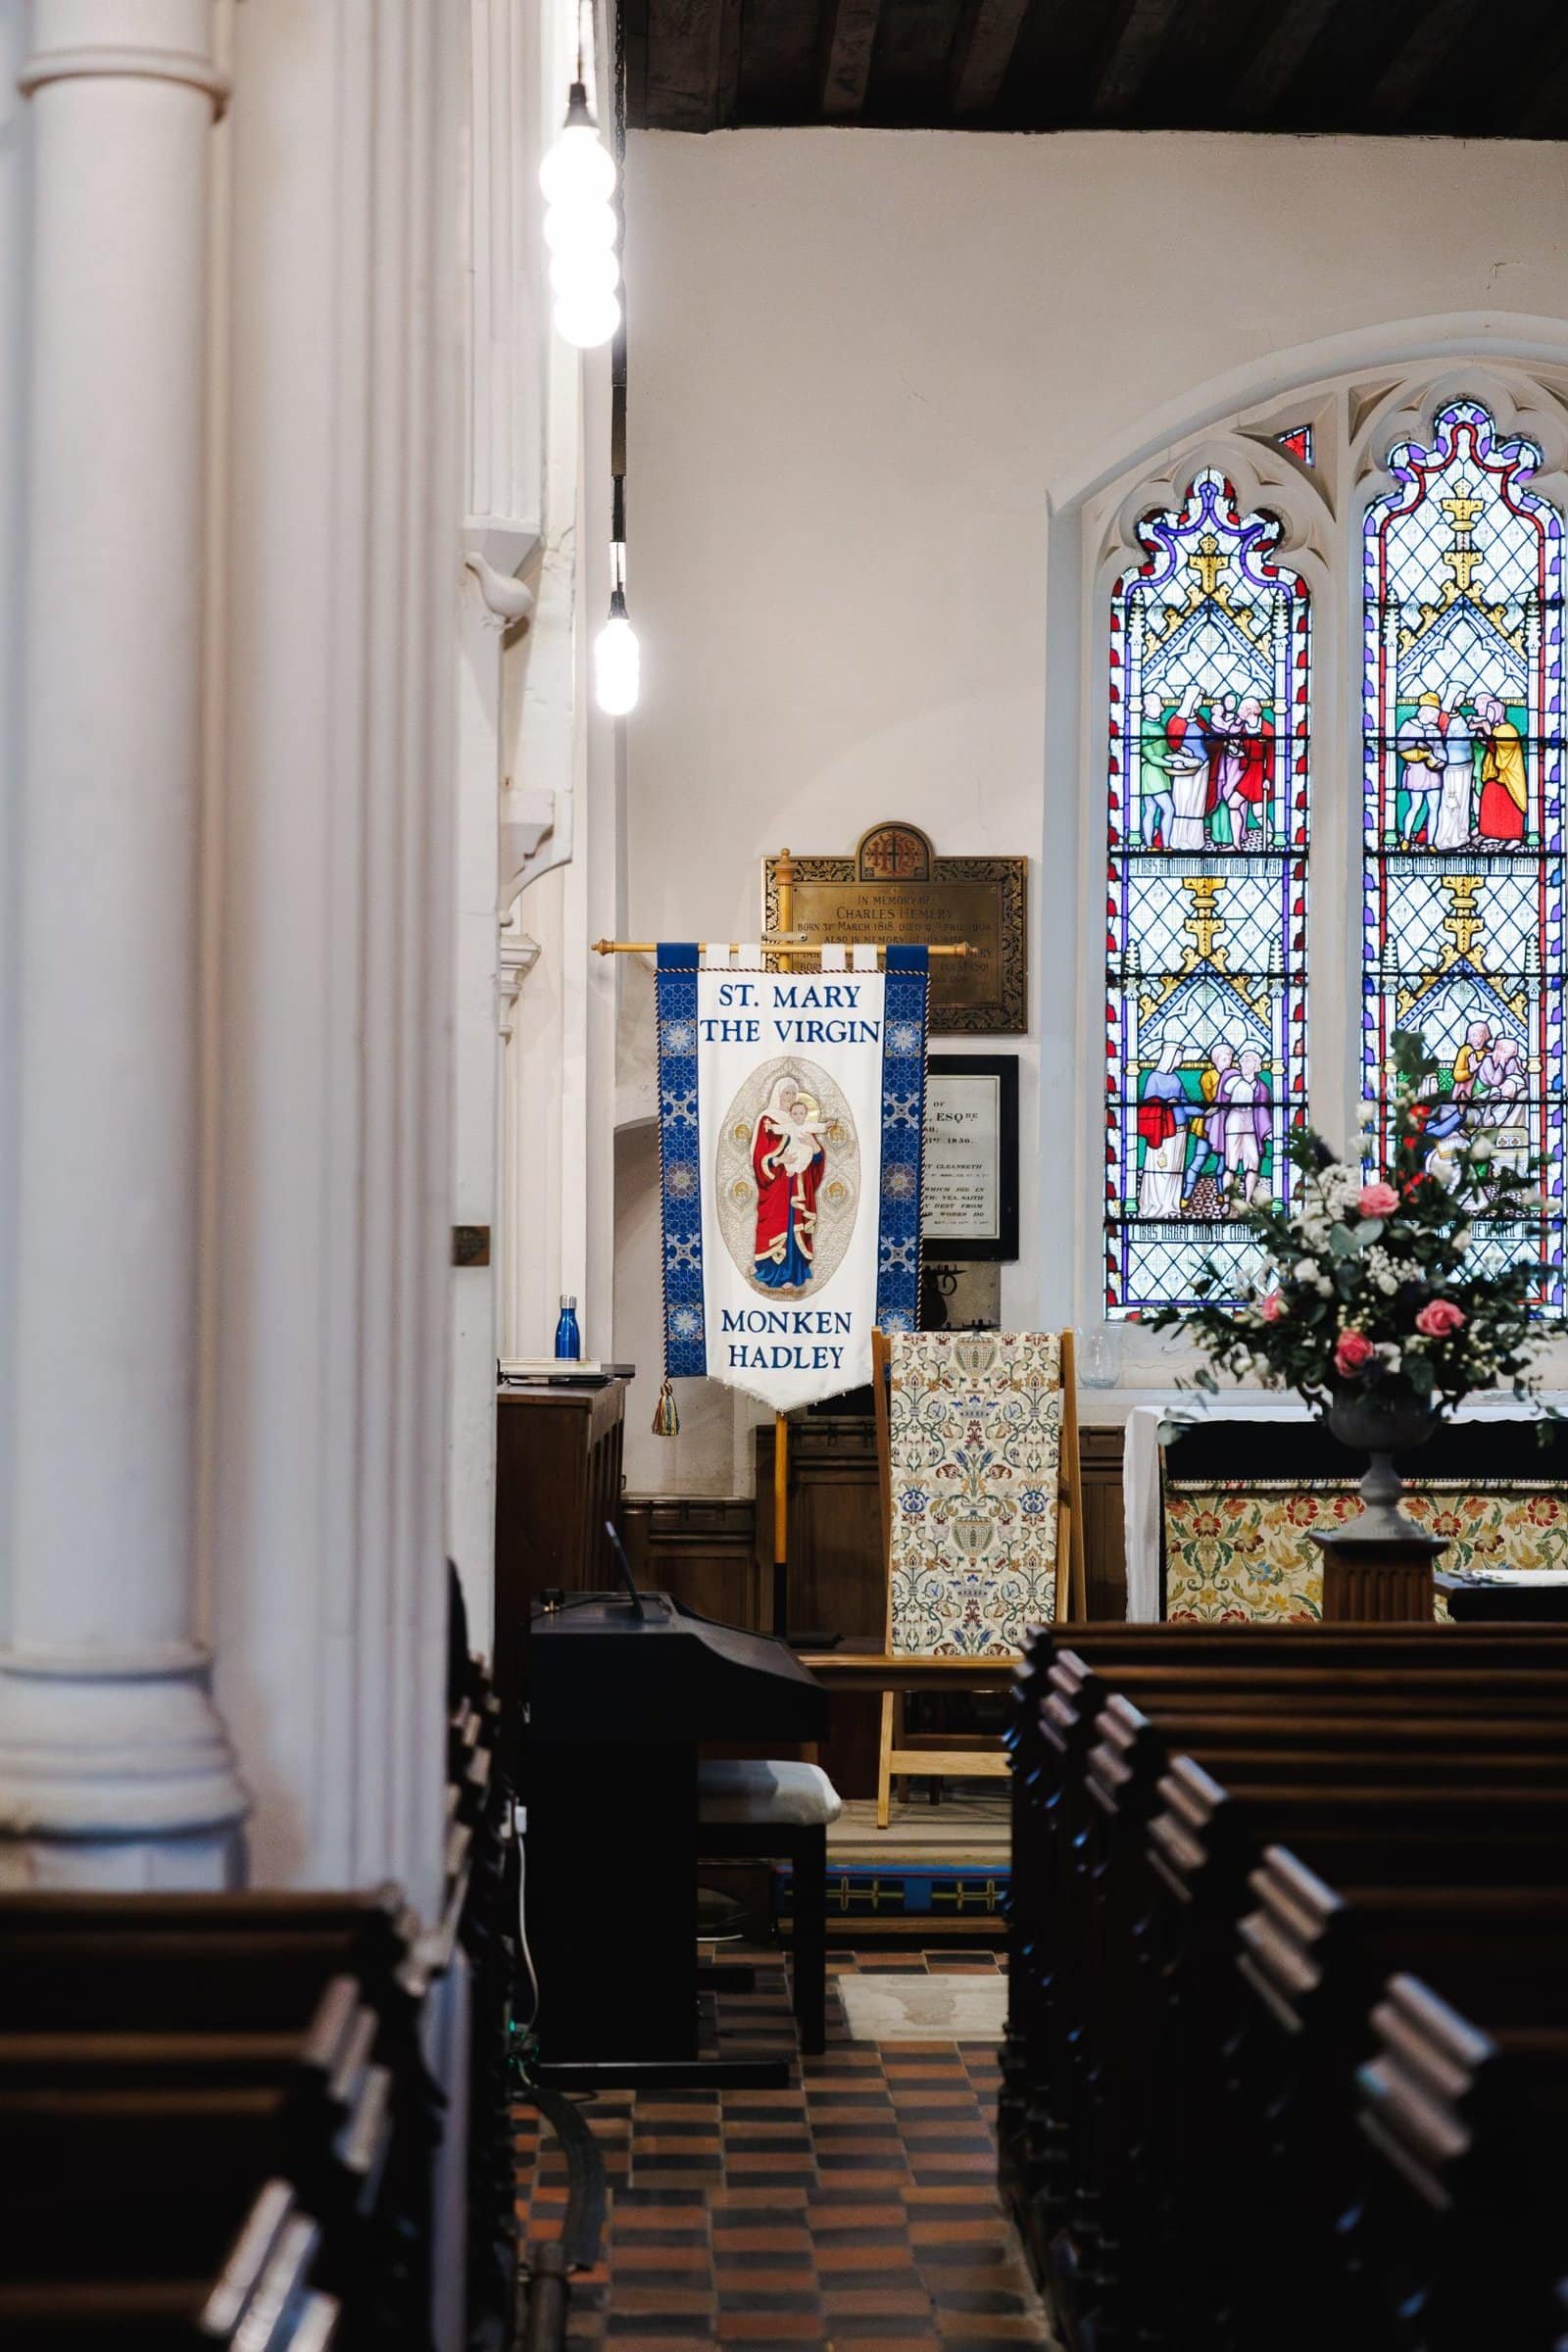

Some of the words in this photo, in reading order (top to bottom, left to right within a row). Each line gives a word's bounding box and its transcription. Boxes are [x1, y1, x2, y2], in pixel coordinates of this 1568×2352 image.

[836, 906, 895, 919] CHARLES
[838, 922, 870, 931] MARCH
[718, 984, 760, 1007] ST.
[773, 985, 861, 1008] MARY
[700, 1019, 760, 1043] THE
[773, 1019, 882, 1044] VIRGIN
[721, 1309, 853, 1334] MONKEN
[728, 1345, 845, 1369] HADLEY
